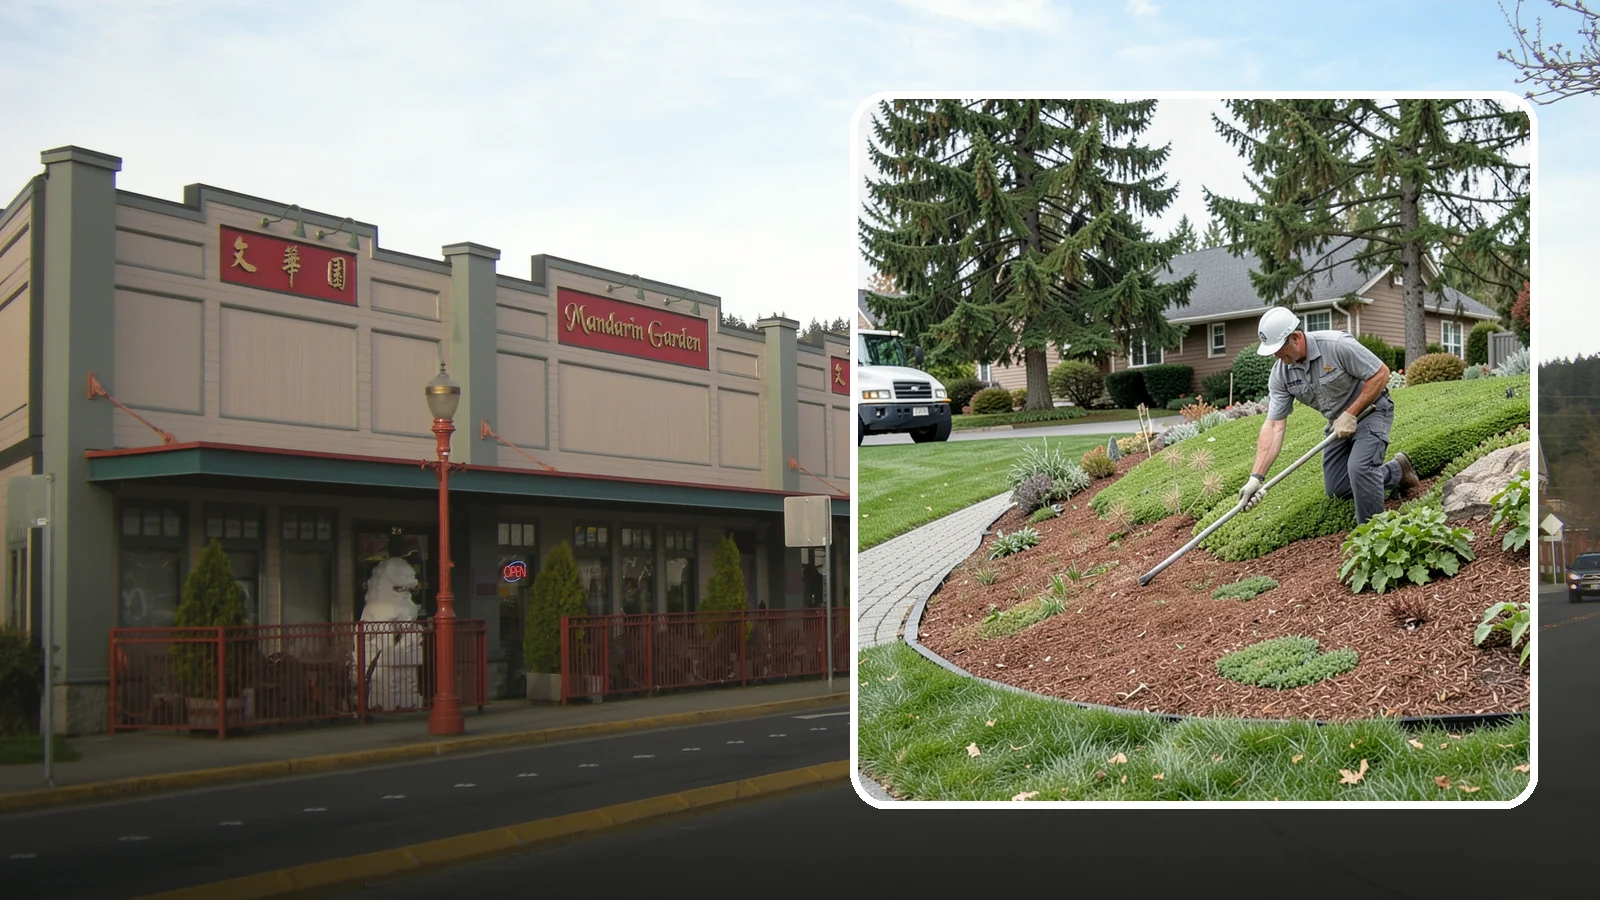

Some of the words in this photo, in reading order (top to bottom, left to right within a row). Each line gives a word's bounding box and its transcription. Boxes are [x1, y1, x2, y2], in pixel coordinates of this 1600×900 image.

[231, 235, 346, 292] 文華園
[564, 302, 644, 341] Mandarin
[647, 320, 702, 352] Garden
[835, 362, 847, 386] 文
[503, 565, 527, 578] OPEN
